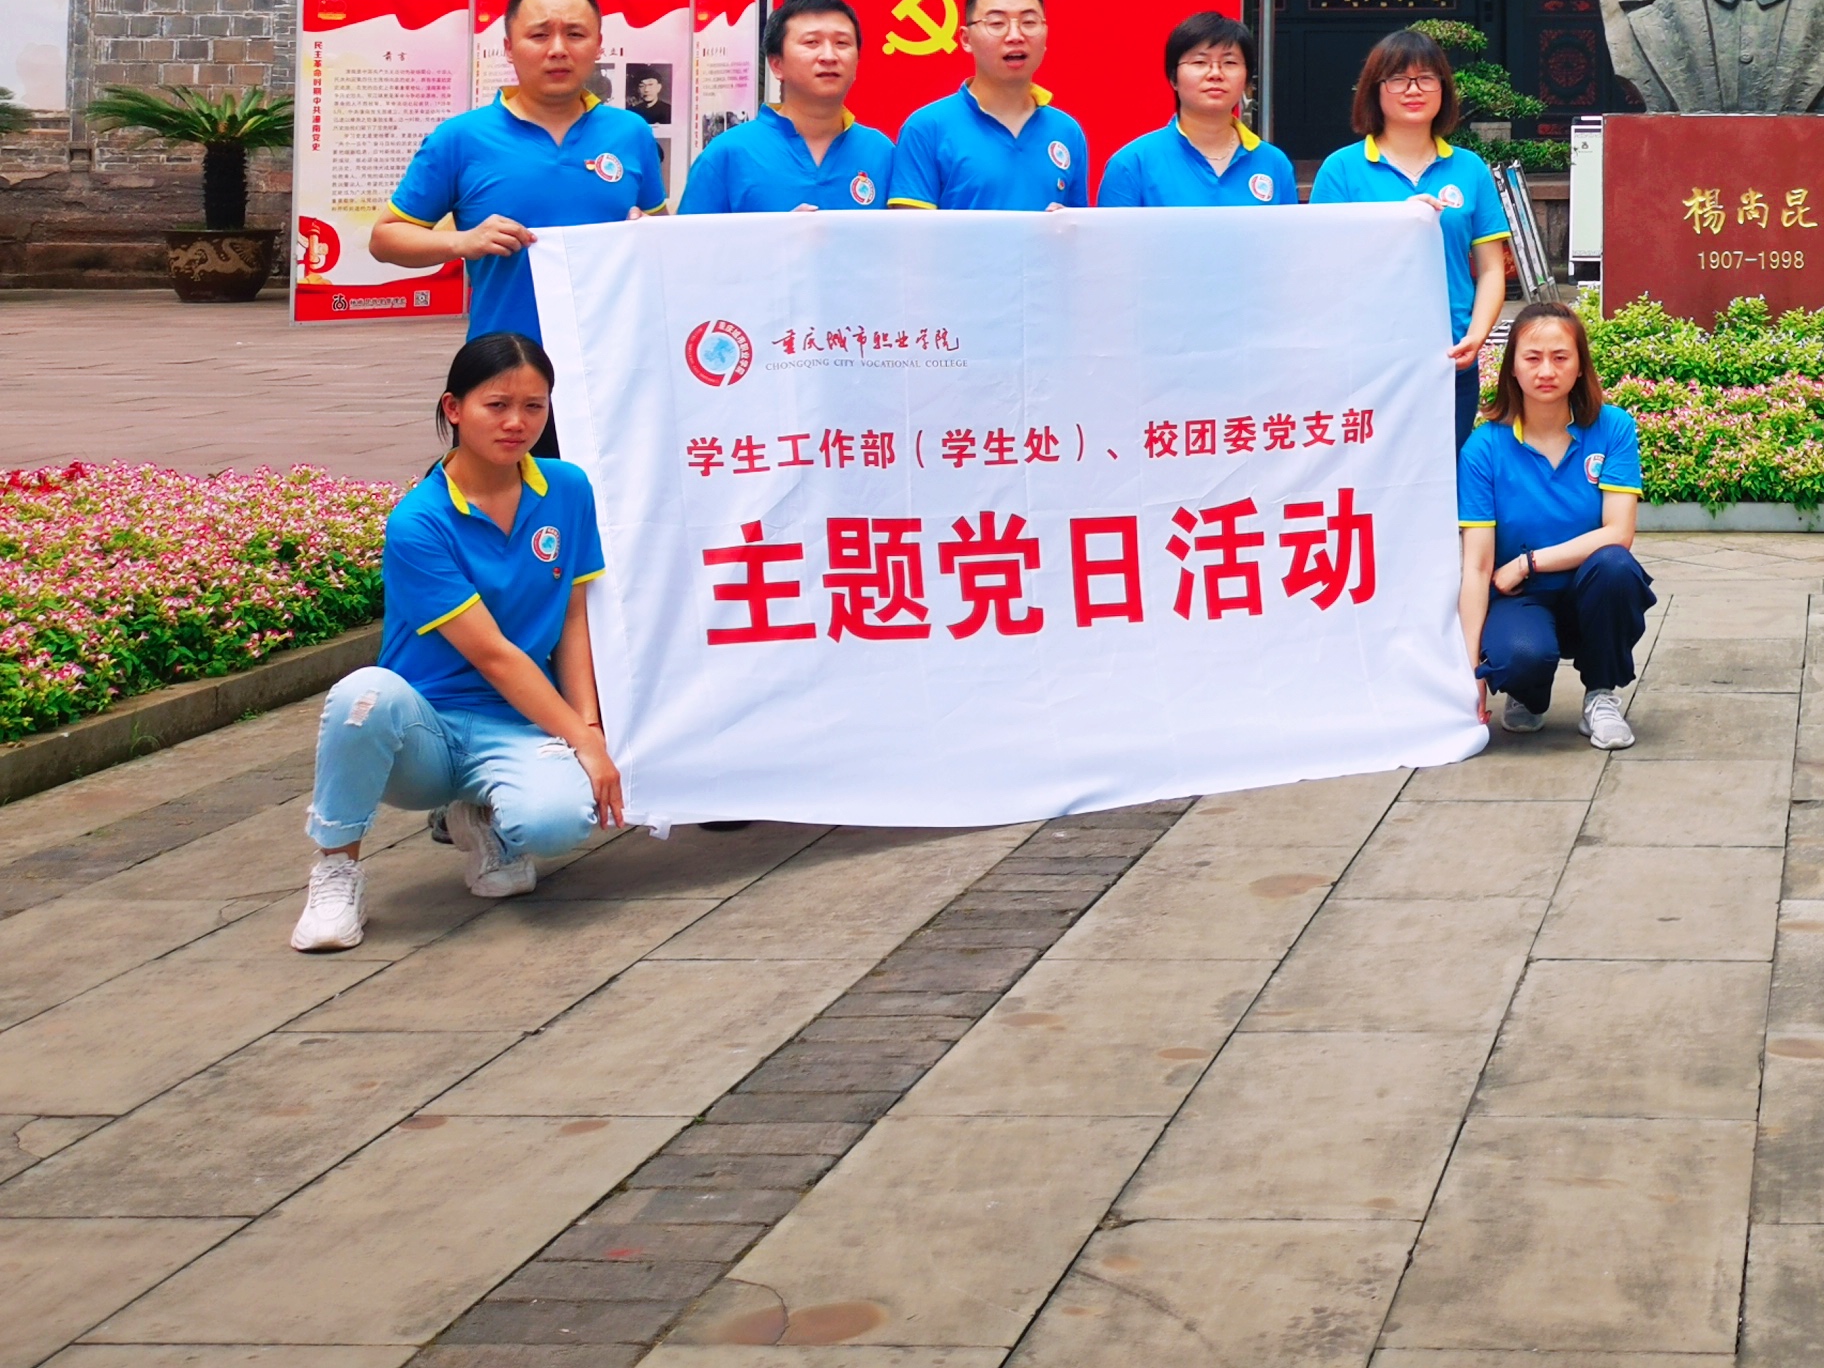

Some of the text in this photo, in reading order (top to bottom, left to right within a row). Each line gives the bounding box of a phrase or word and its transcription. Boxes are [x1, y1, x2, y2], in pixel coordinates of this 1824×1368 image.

[1682, 187, 1819, 236] 楊尚昆
[1697, 250, 1806, 270] 1907-1998
[772, 325, 960, 358] 重庆城市职业学院
[765, 358, 969, 371] CHONGQING CITY VOCATIONAL COLLEGE
[701, 486, 1378, 647] 主题党日活动
